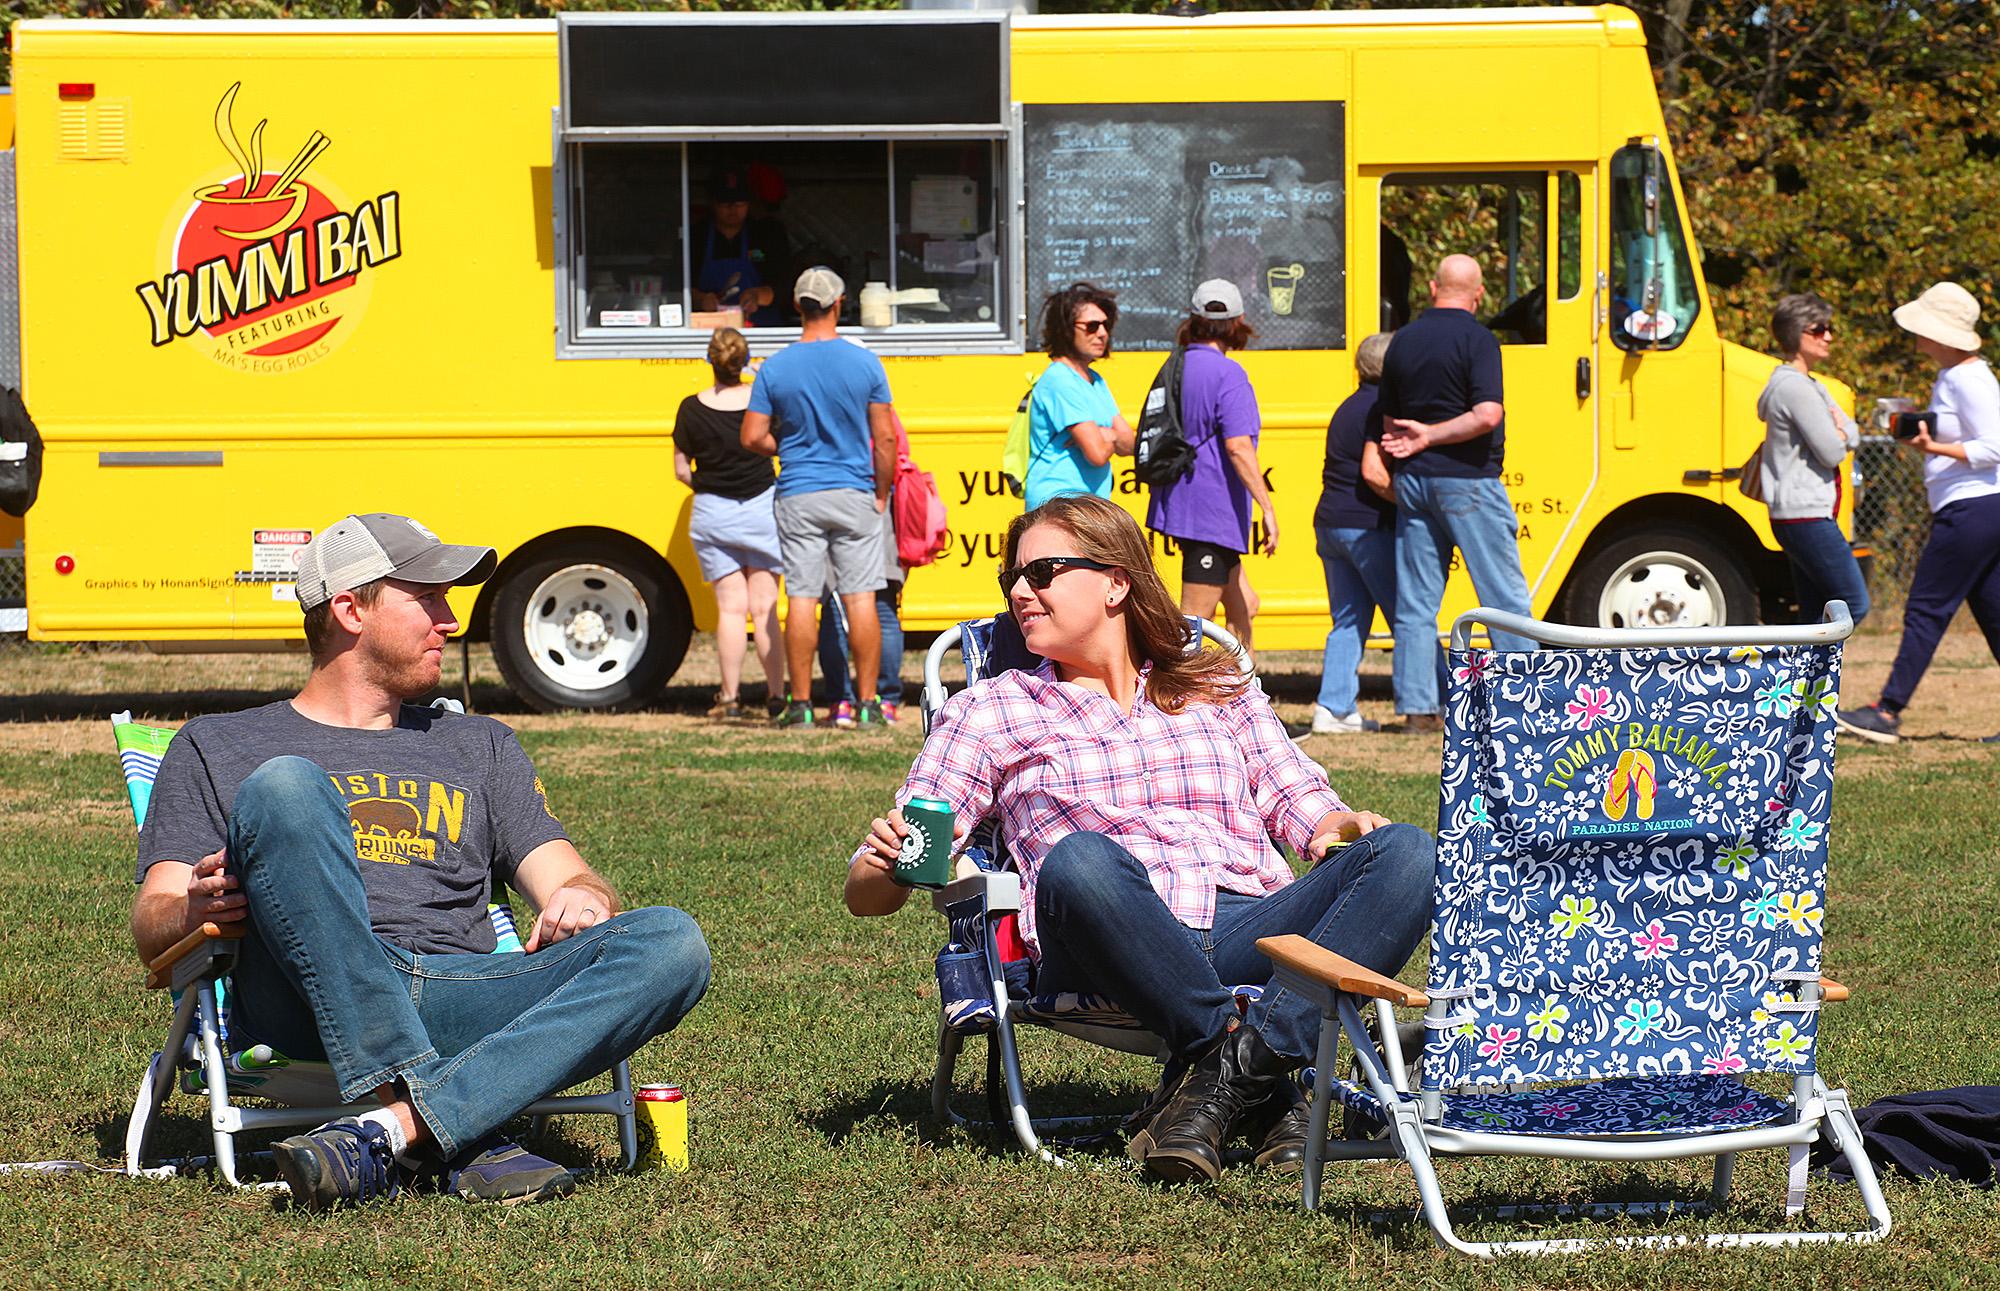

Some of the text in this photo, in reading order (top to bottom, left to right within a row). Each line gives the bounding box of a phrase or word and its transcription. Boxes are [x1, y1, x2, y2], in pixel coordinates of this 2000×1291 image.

[1209, 160, 1252, 176] Drinks
[1209, 186, 1334, 205] Bubble Tea $3.00
[136, 191, 402, 347] YUMM BAI
[227, 300, 331, 349] FEATURING
[213, 342, 331, 373] MA'S EGG ROLLS
[1504, 473, 1525, 487] 19
[1542, 498, 1569, 514] St.
[260, 531, 305, 543] DANGER
[1518, 525, 1532, 540] A
[85, 578, 138, 591] Graphics
[143, 578, 156, 590] by
[1544, 722, 1729, 790] TOMMY BAHAMA
[1572, 818, 1694, 836] PARADISE NATION
